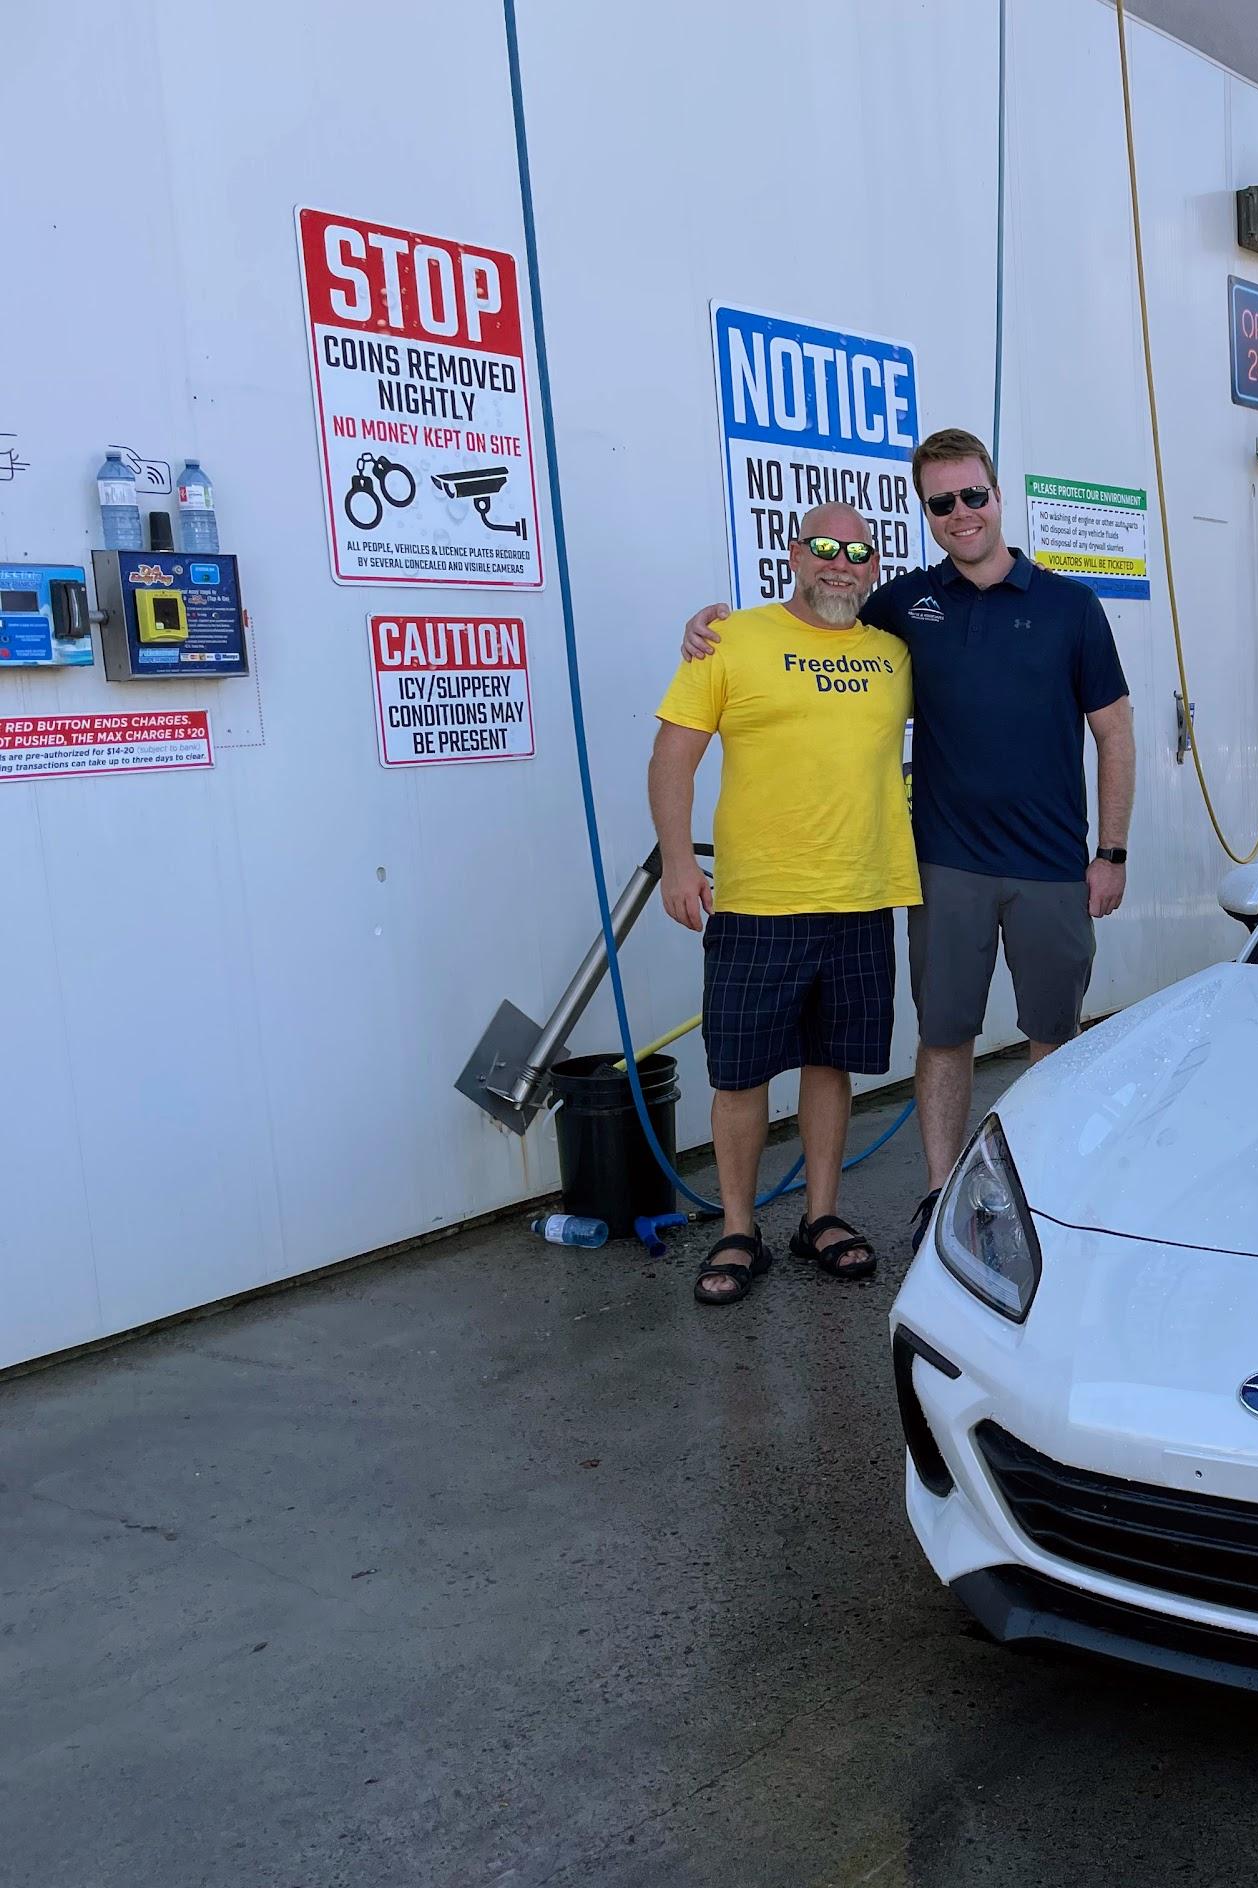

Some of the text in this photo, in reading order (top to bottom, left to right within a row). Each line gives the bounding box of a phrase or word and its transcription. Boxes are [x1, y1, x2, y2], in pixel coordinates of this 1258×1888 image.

[323, 224, 502, 342] STOP
[324, 334, 516, 394] COINS REMOVED
[727, 326, 913, 448] NOTICE
[378, 379, 475, 422] NIGHTLY
[333, 415, 522, 457] NO MONEY KEPT ON SITE
[746, 457, 910, 514] NO TRUCK OR
[1033, 482, 1141, 506] PLEASE PROTECT OUR ENVIRONMENT
[1040, 511, 1048, 520] NO
[1049, 512, 1071, 524] washing
[1078, 517, 1095, 526] engine
[1101, 518, 1114, 526] other
[1040, 524, 1049, 533] NO
[1050, 525, 1071, 535] disposal
[1072, 527, 1077, 535] of
[1078, 530, 1087, 538] any
[1088, 530, 1105, 539] vehicle
[347, 541, 530, 561] ALL PEOPLE, VEHICLES & LICENCE PLATES RECORDED
[1041, 537, 1050, 545] NO
[1050, 538, 1072, 548] disposal
[1078, 542, 1088, 550] any
[358, 557, 524, 574] BY SEVERAL CONCEALED AND VISIBLE CAMERAS
[1048, 555, 1134, 570] VIOLATORS WILL BE TICKETED
[378, 622, 521, 666] CAUTION
[783, 653, 893, 674] Freedom's
[398, 674, 511, 702] ICY/SLIPPERY
[816, 674, 868, 693] Door
[5, 715, 191, 733] RED BUTTON ENDS CHARGES.
[388, 701, 524, 728] CONDITIONS MAY
[14, 734, 67, 747] PUSHED,
[71, 733, 94, 743] THE
[97, 731, 122, 742] MAX
[125, 729, 172, 740] CHARGE
[175, 728, 185, 739] IS
[187, 728, 205, 738] $20
[413, 728, 507, 754] BE PRESENT
[16, 761, 69, 771] transactions
[88, 758, 107, 766] take
[108, 758, 119, 766] up
[132, 755, 153, 763] three
[155, 754, 173, 764] days
[175, 753, 184, 761] to
[25, 749, 90, 761] pre-authorized
[92, 747, 105, 756] for
[107, 746, 134, 756] $14-20
